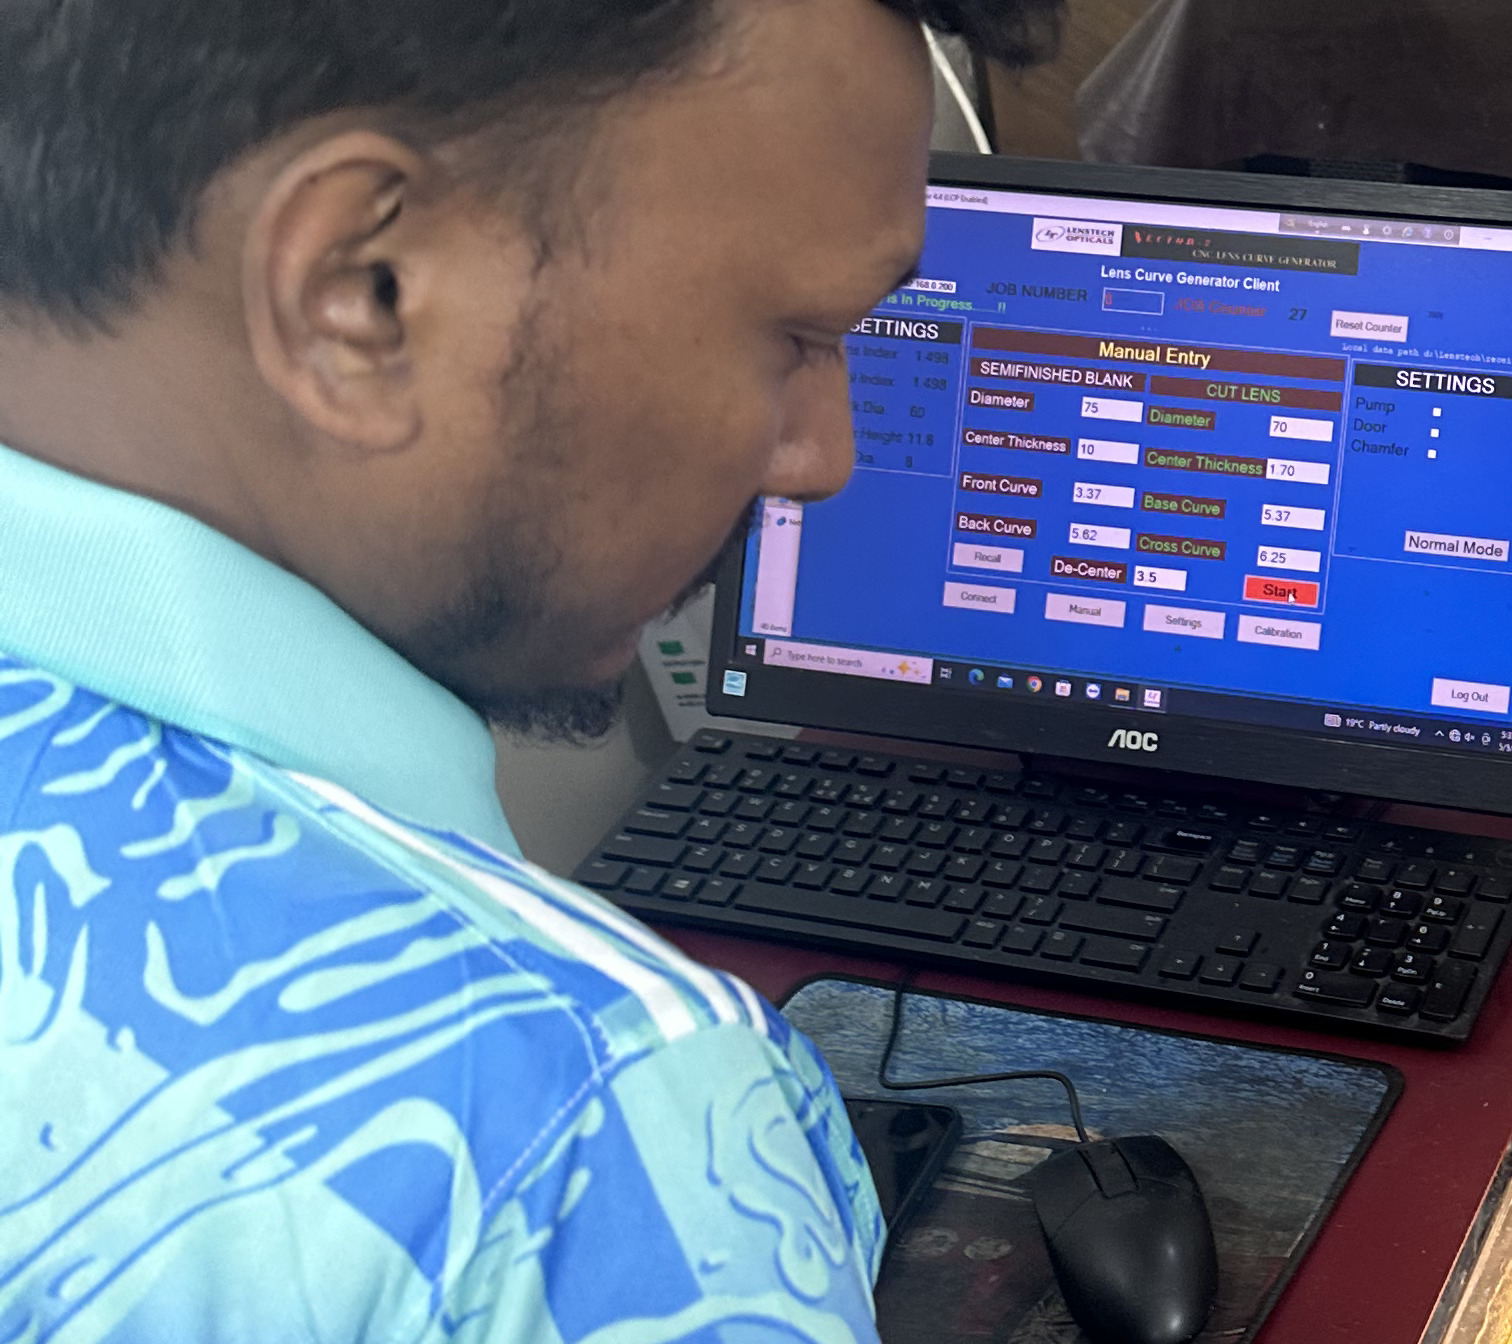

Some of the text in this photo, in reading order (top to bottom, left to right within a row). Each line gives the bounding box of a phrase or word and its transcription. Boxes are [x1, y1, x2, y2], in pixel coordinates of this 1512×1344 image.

[1065, 235, 1114, 245] OPTICALS
[1066, 226, 1115, 237] LENSTECH
[1278, 256, 1337, 269] GENERATOR
[1100, 265, 1280, 293] Lens Curve Generator Client
[886, 294, 898, 305] is
[901, 293, 913, 306] In
[986, 282, 1088, 302] JOB NUMBER
[1173, 298, 1267, 318] JOB Counter
[1287, 308, 1308, 322] 27
[1335, 318, 1402, 334] Reset Counter
[1099, 341, 1211, 370] Manual Entry
[1341, 342, 1368, 354] Local
[1372, 344, 1394, 355] data
[1396, 345, 1419, 358] path
[980, 361, 1133, 388] SEMIFINISHED BLANK
[1396, 370, 1496, 395] SETTINGS
[970, 390, 1029, 409] Diameter
[1206, 383, 1281, 403] CUT LENS
[1084, 401, 1099, 414] 75
[1355, 396, 1396, 414] Pump
[1150, 408, 1211, 428] Diameter
[1272, 420, 1288, 433] 70
[1353, 418, 1387, 434] Door
[965, 431, 1067, 453] Center Thickness
[1081, 443, 1095, 455] 10
[1350, 439, 1410, 457] Chamfer
[1147, 451, 1263, 475] Center Thickness
[1269, 464, 1295, 477] 1.70
[962, 474, 1038, 496] Front Curve
[1075, 486, 1102, 500] 3.37
[1144, 495, 1221, 516] Base Curve
[1263, 508, 1291, 522] 5.37
[958, 515, 1032, 536] Back Curve
[1071, 527, 1098, 541] 5.62
[1139, 536, 1221, 558] Cross Curve
[1408, 535, 1504, 557] Normal Mode
[974, 551, 1001, 563] Recall
[1259, 550, 1287, 564] 6.25
[1053, 559, 1123, 580] De-Center
[1136, 570, 1157, 583] 3.5
[1262, 583, 1298, 600] Start
[960, 591, 1302, 640] Connect Manual Settings Calibration
[1451, 688, 1489, 703] Log Out
[1368, 720, 1392, 735] Partly
[1393, 723, 1421, 738] cloudy
[1108, 727, 1160, 754] AOC
